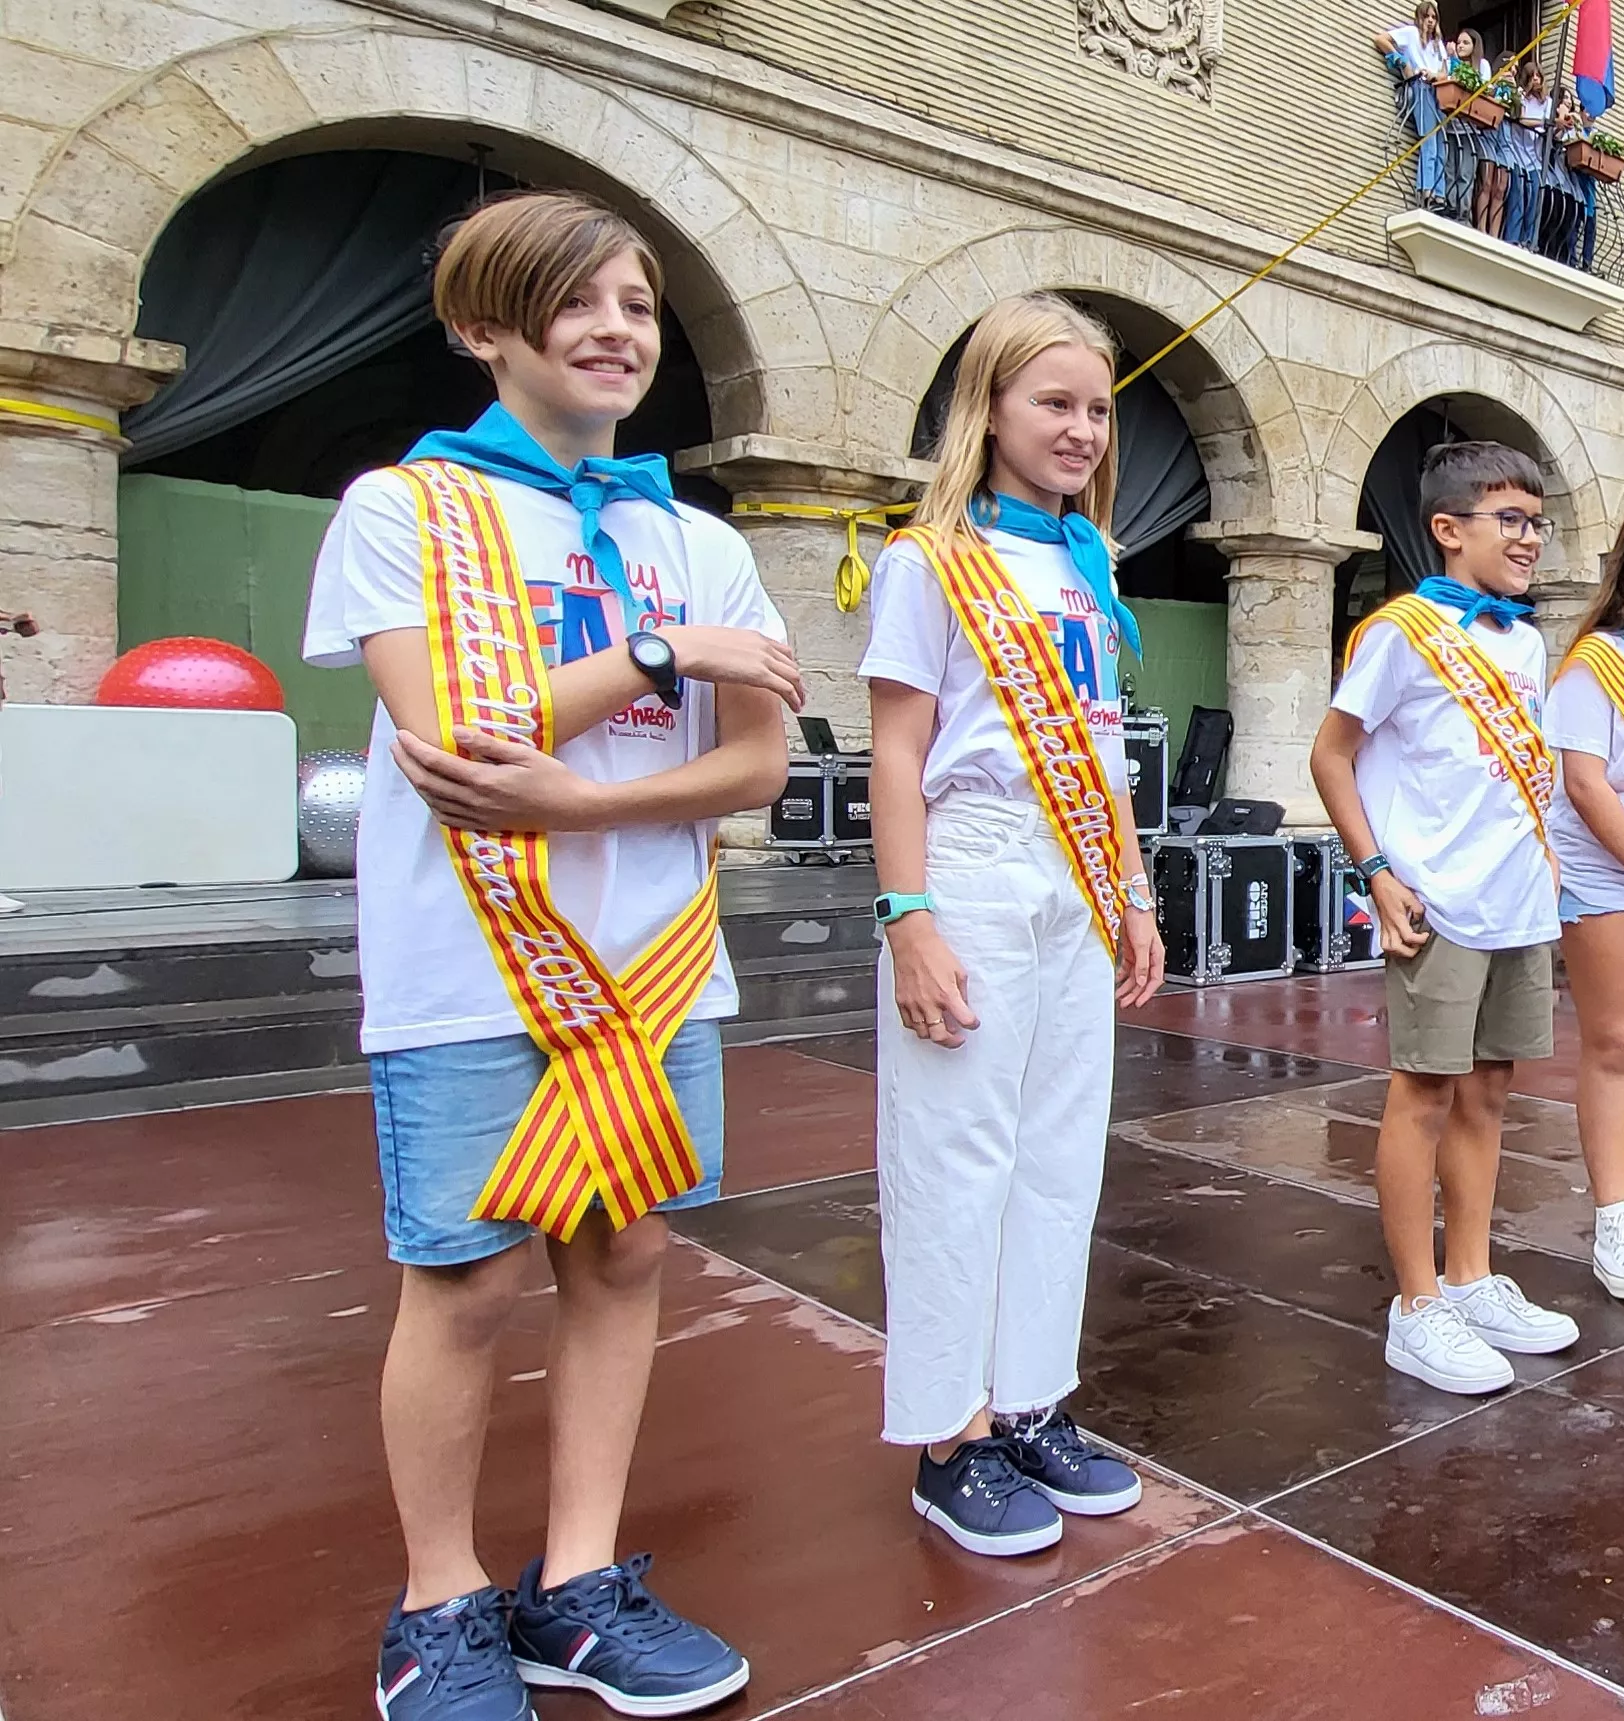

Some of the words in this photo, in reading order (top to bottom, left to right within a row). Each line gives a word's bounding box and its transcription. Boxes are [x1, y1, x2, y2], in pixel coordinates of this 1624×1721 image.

[973, 589, 1090, 802] Zagaleta
[1249, 881, 1260, 939] PRO
[509, 931, 616, 1028] 2024
